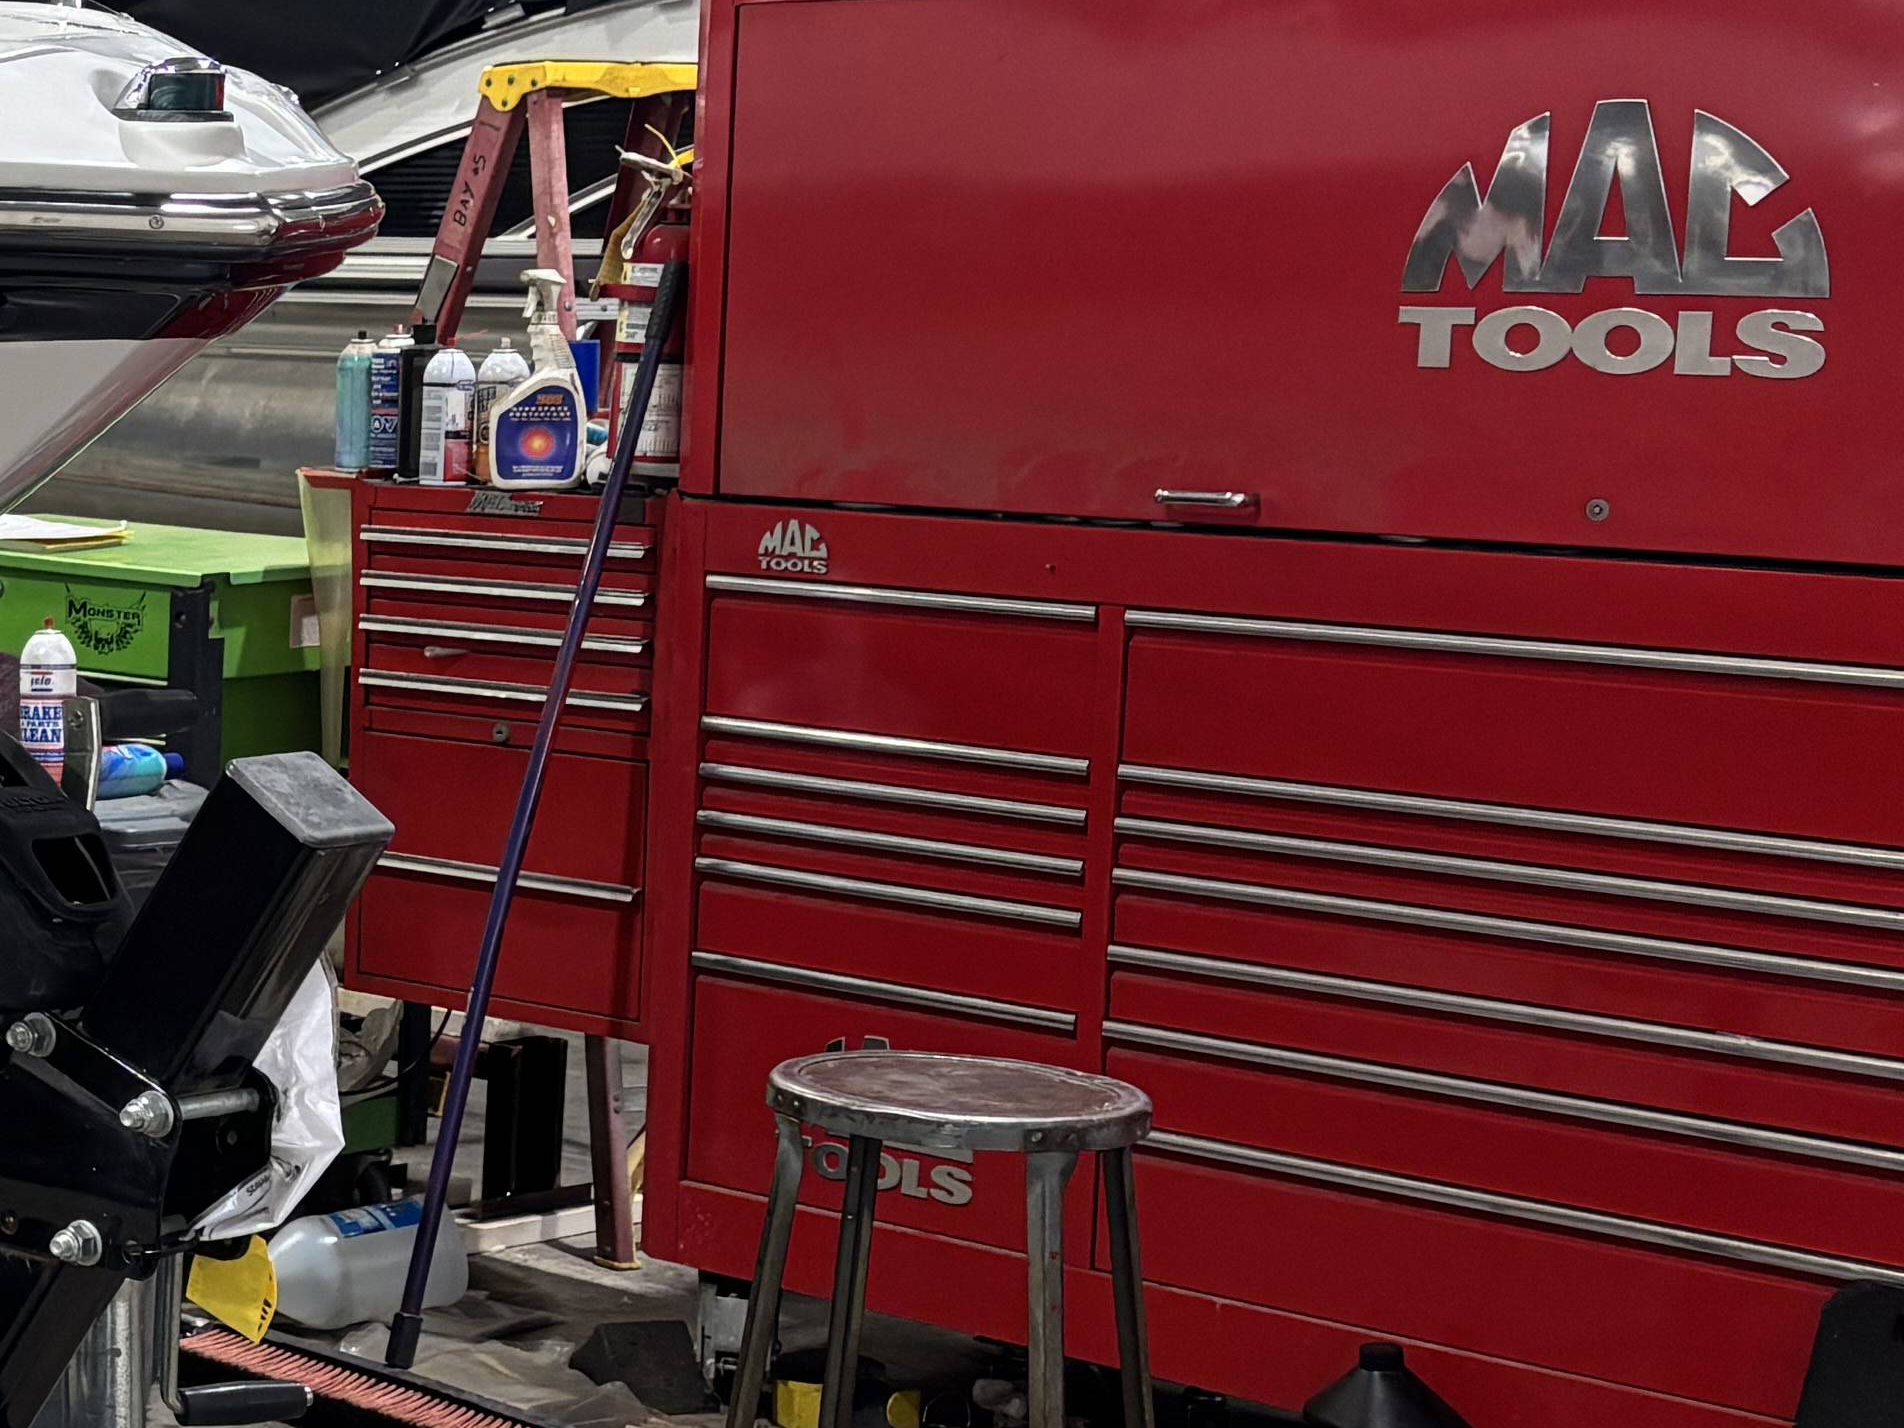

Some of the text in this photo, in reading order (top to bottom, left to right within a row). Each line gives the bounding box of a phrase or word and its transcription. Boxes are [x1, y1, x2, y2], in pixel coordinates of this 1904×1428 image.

[453, 180, 476, 227] BAY
[1400, 98, 1830, 299] MAC
[1397, 305, 1827, 380] TOOLS
[757, 518, 829, 559] MAC
[757, 556, 828, 574] TOOLS
[801, 1135, 974, 1205] OOLS
